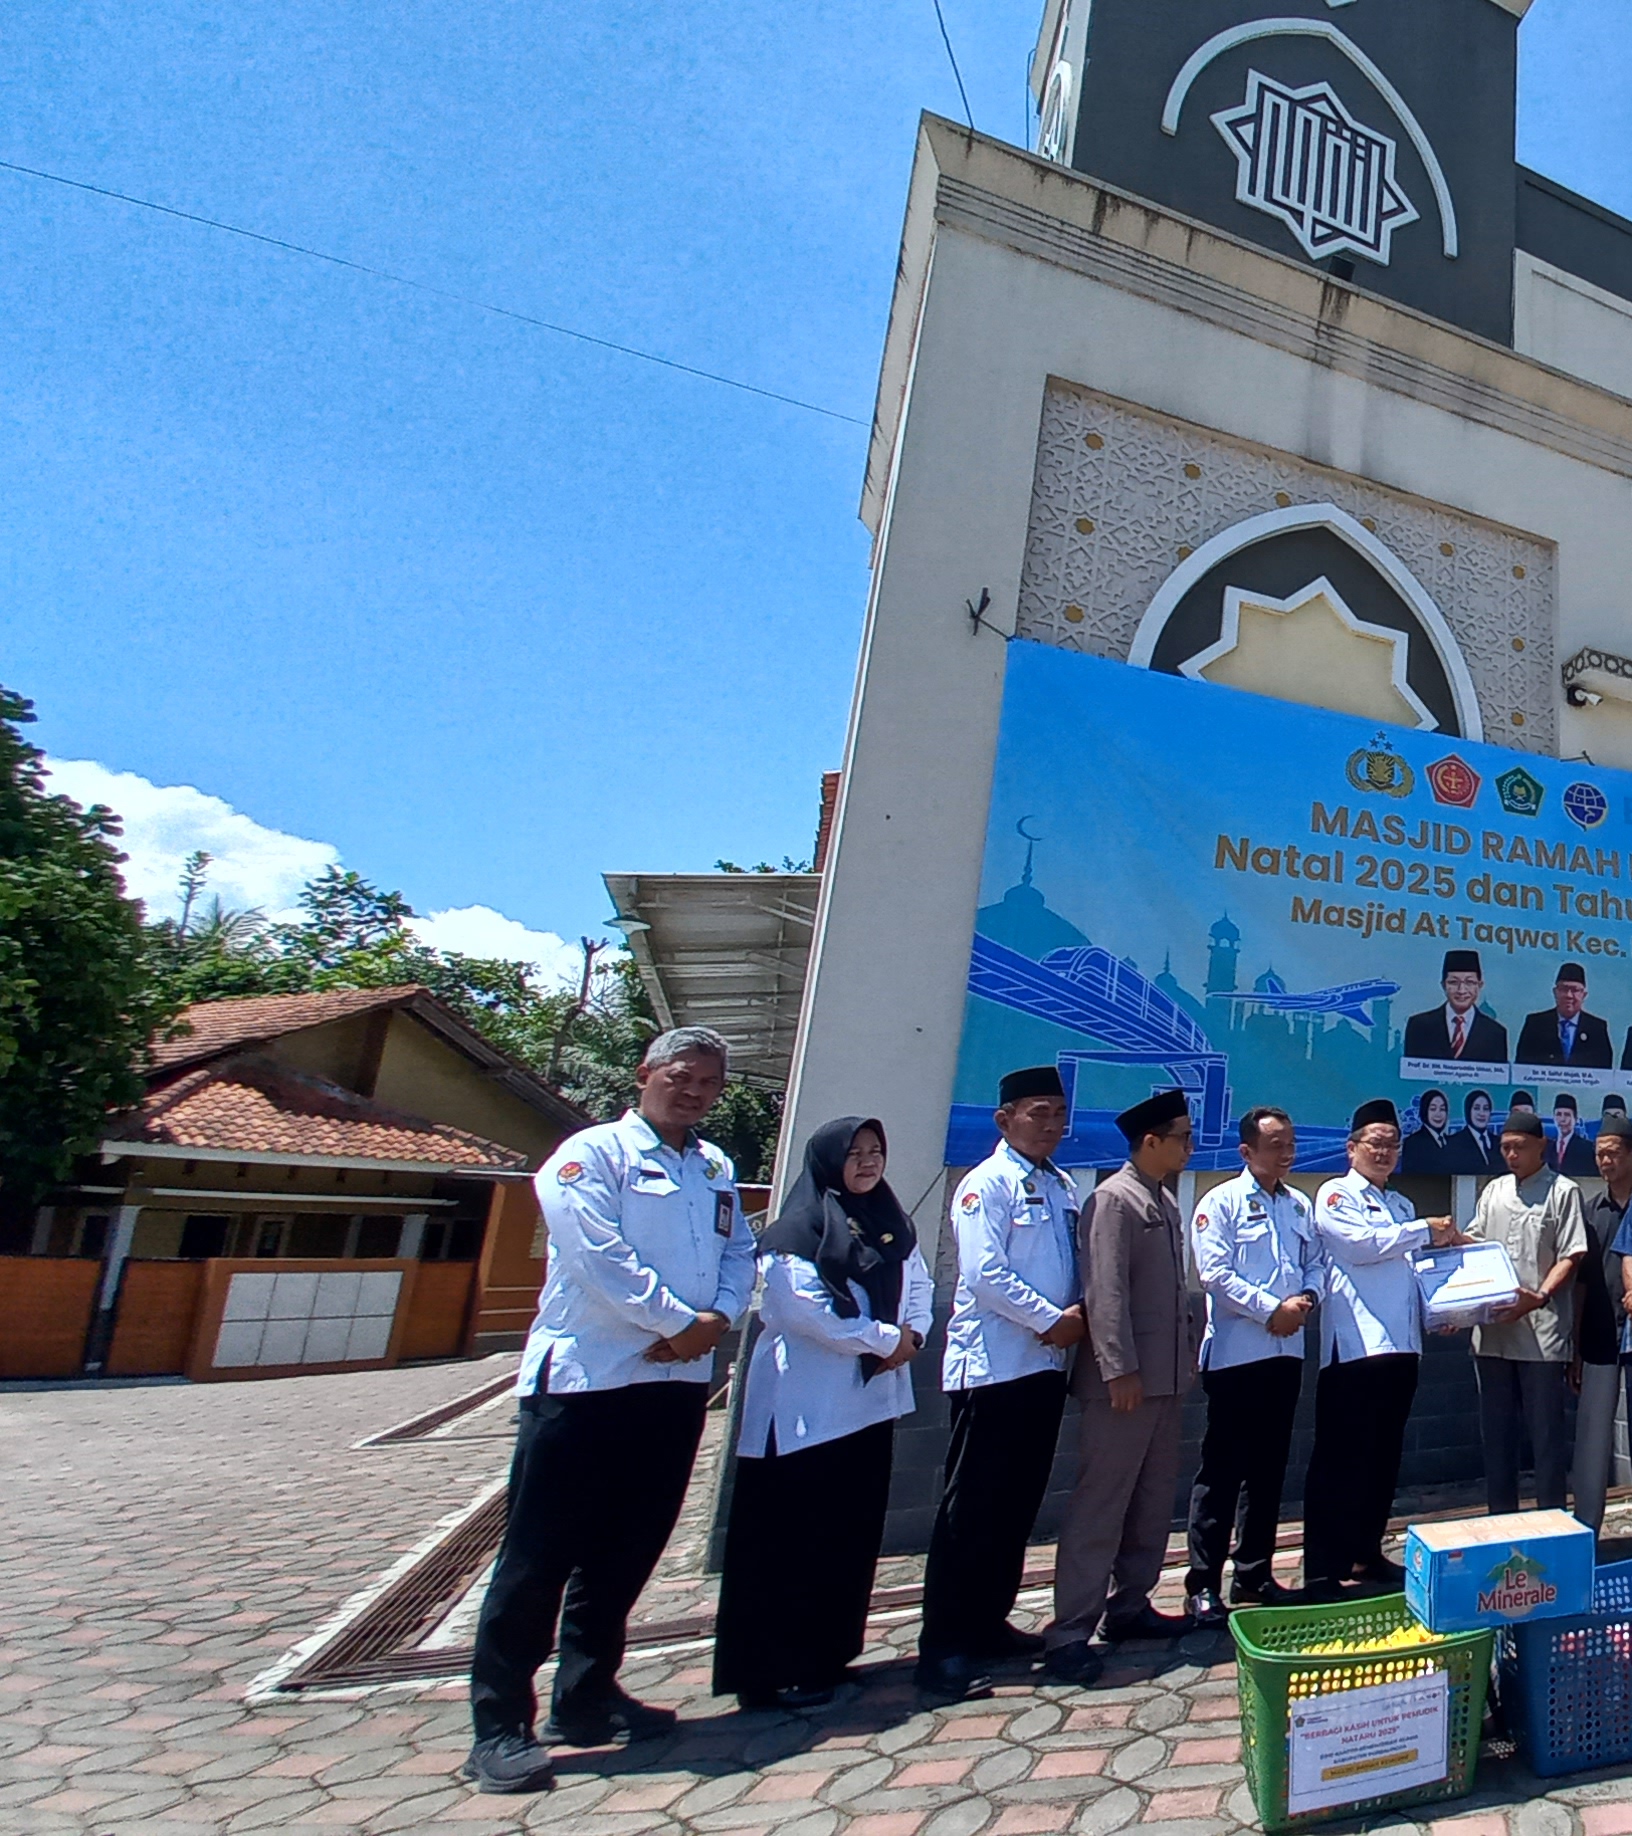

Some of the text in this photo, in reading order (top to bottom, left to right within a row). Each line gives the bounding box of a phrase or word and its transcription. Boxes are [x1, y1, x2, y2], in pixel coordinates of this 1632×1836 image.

[1310, 801, 1472, 856] MASJID
[1481, 831, 1620, 879] RAMAH
[1214, 834, 1344, 884] Natal
[1355, 854, 1456, 899] 2025
[1466, 872, 1545, 912] dan
[1291, 896, 1407, 939] Masjid
[1413, 911, 1450, 939] At
[1456, 915, 1560, 954] Taqwa
[1566, 929, 1627, 958] Kec.
[1504, 1569, 1527, 1591] Le
[1477, 1583, 1557, 1613] Minerale
[1343, 1719, 1370, 1734] KASIH
[1371, 1712, 1400, 1728] UNTUK
[1401, 1705, 1440, 1721] PEMUDIK
[1341, 1731, 1377, 1745] NATARU
